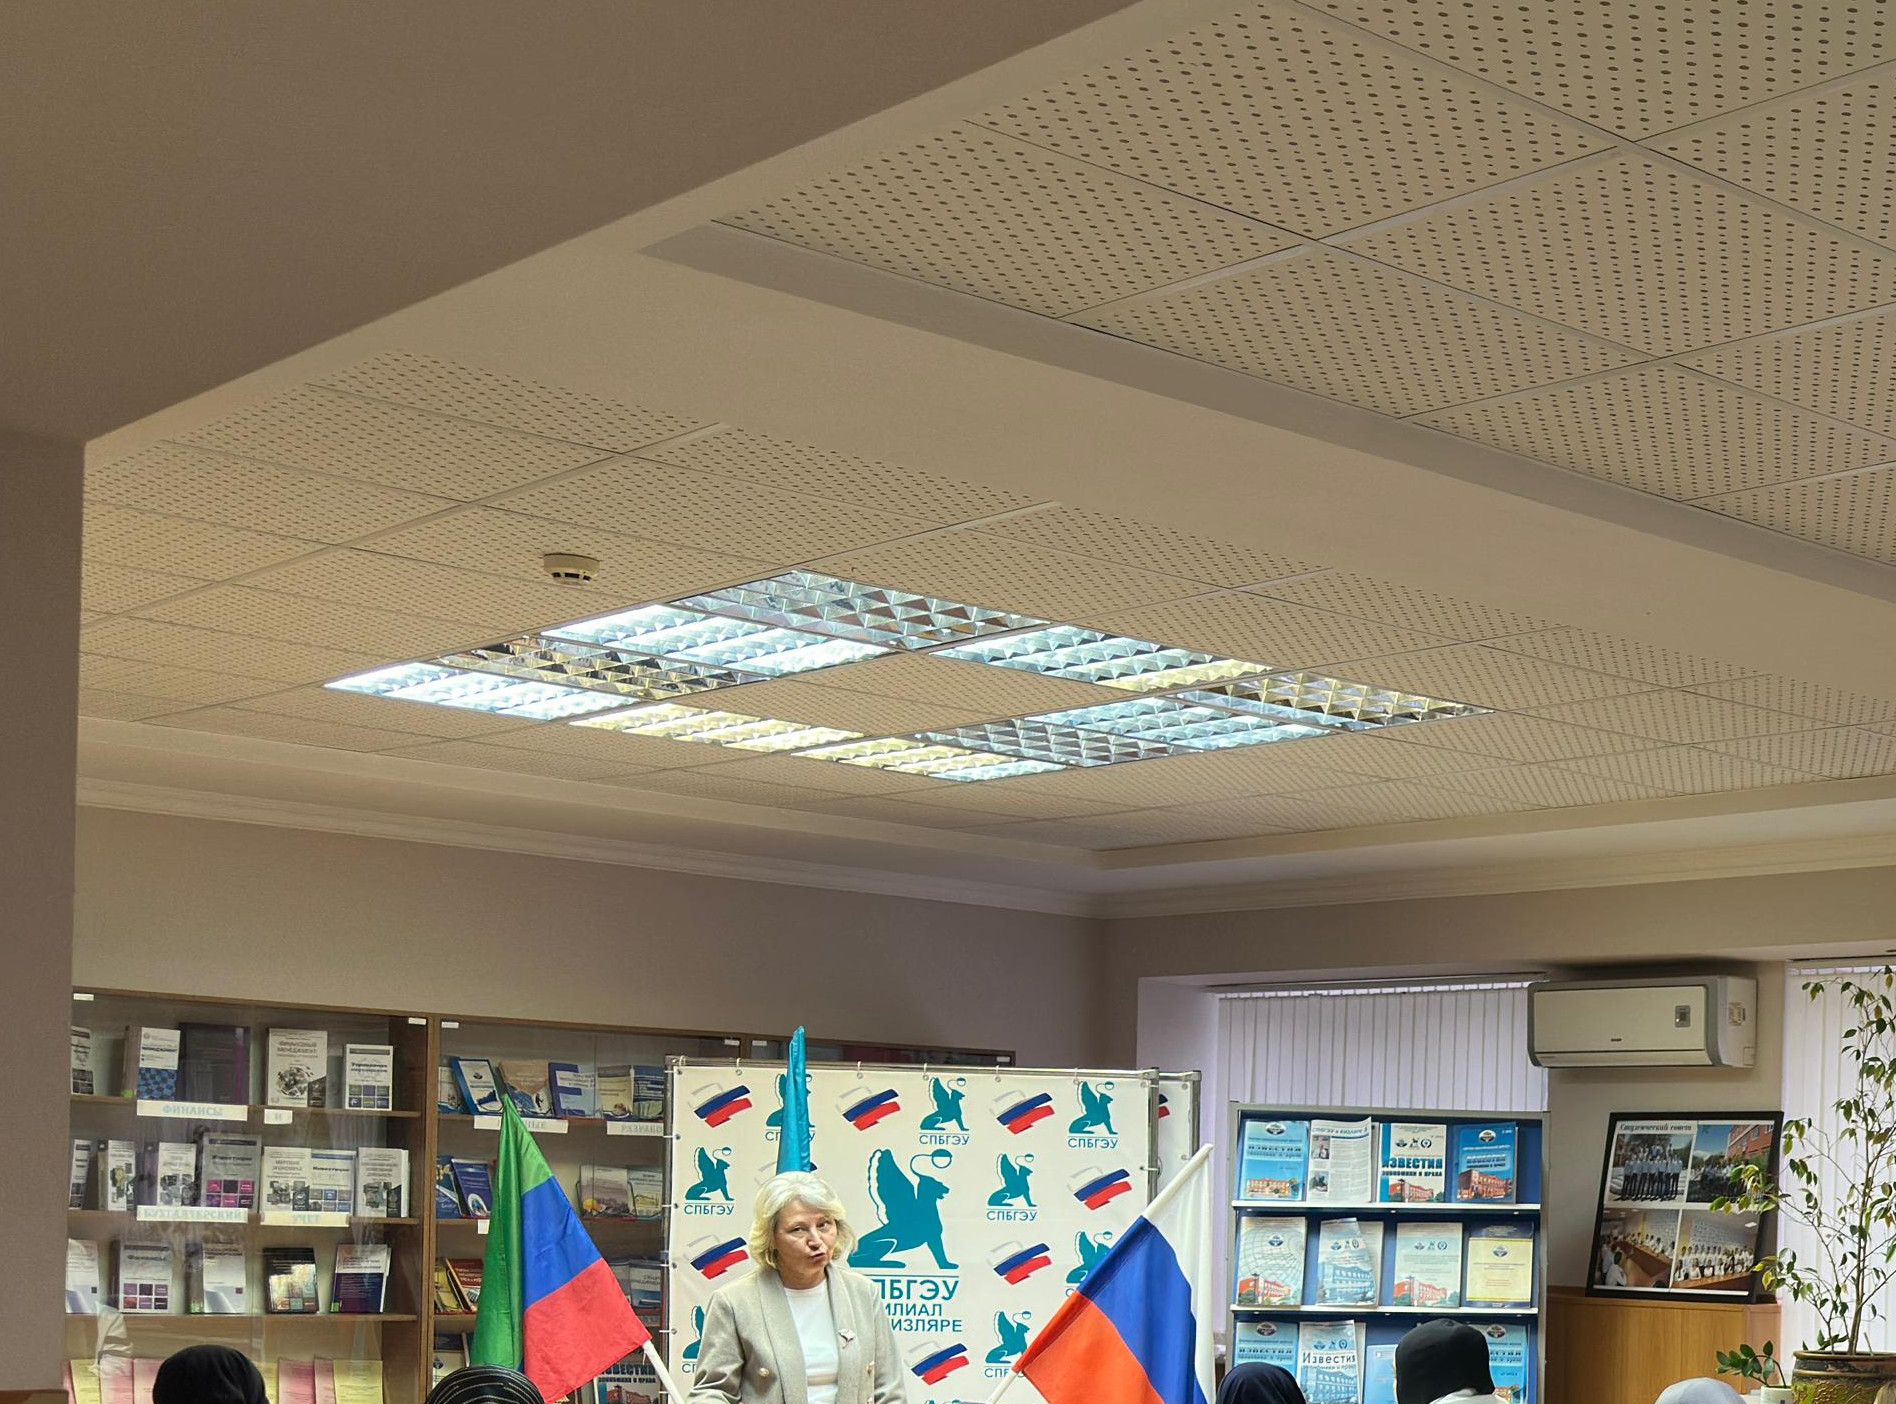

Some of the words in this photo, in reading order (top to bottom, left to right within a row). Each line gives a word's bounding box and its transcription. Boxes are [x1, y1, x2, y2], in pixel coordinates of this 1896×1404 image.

[162, 1104, 223, 1117] ФИНАНСЫ
[919, 1134, 970, 1145] СПБГЭУ
[1067, 1138, 1119, 1149] СПБГЭУ
[684, 1204, 735, 1216] СПБГЭУ
[986, 1210, 1038, 1222] СПБГЭУ
[872, 1278, 960, 1301] ПБГЭУ
[885, 1303, 943, 1317] ИЛИАЛ
[891, 1319, 963, 1333] ИЗЛЯРЕ
